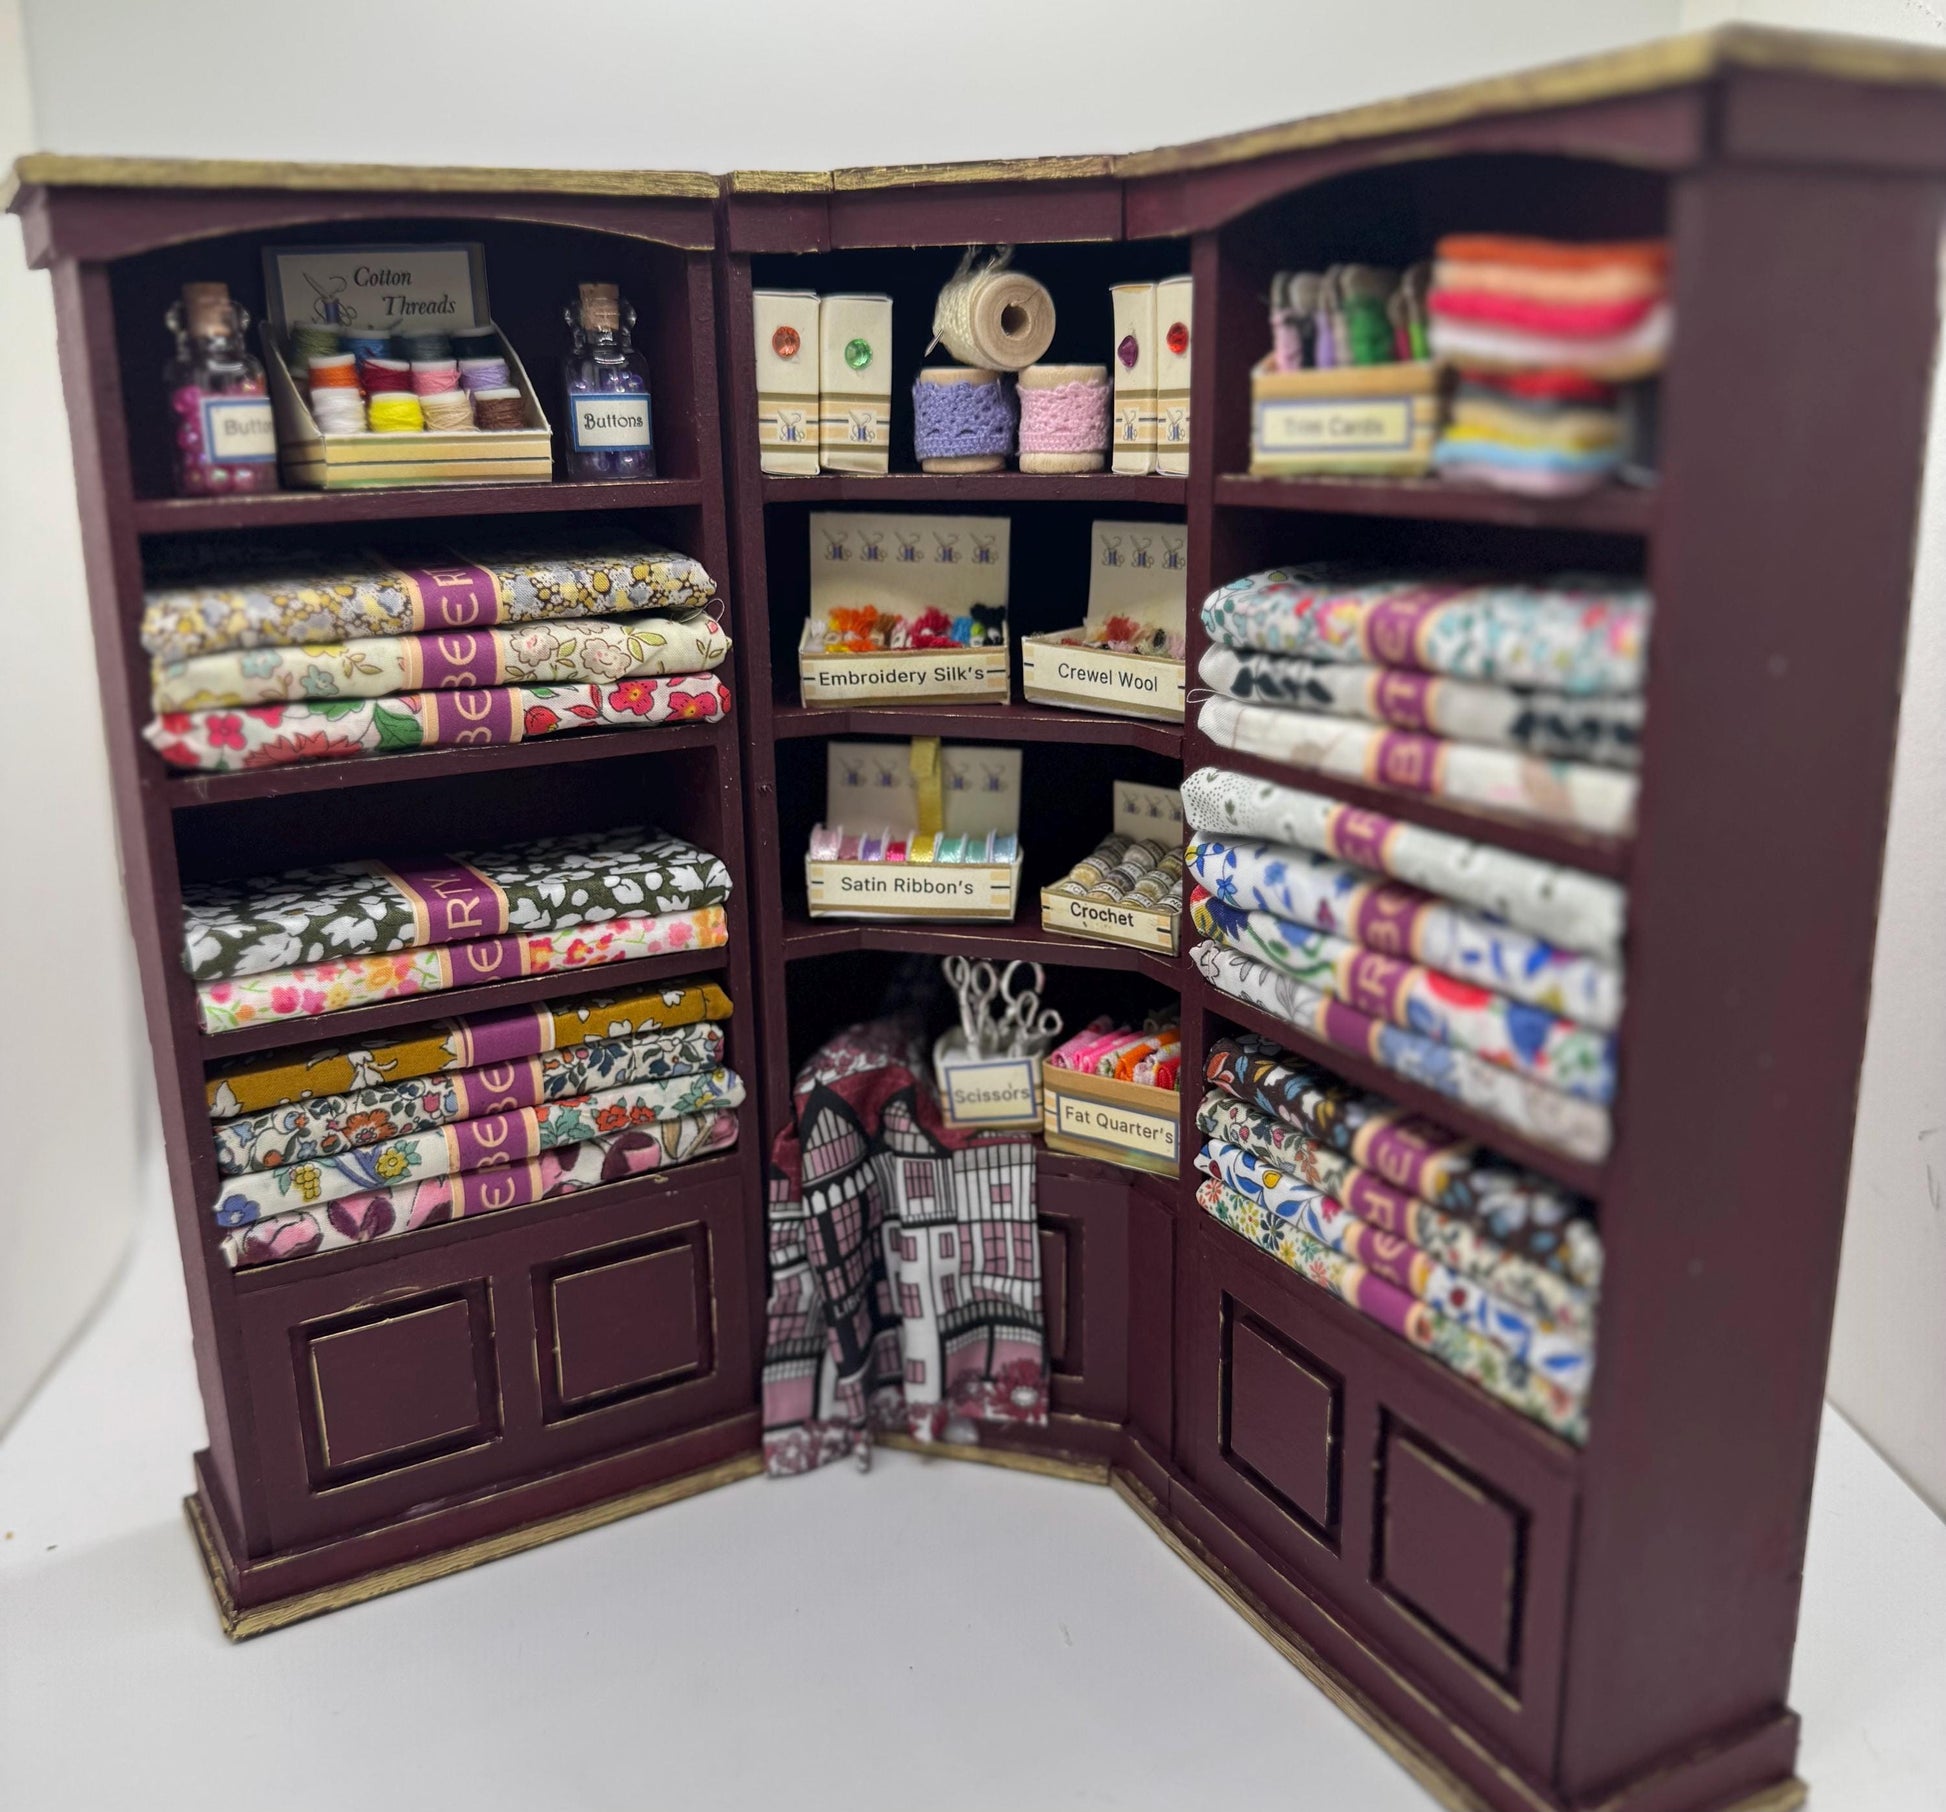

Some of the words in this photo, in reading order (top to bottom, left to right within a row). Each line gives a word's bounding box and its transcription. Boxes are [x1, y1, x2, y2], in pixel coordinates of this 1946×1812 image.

[354, 266, 412, 287] Cotton
[382, 294, 456, 316] Threads
[584, 413, 643, 430] Buttons
[819, 669, 926, 686] Embroidery
[934, 666, 984, 681] Silk's
[1058, 663, 1112, 685] Crewel
[1118, 671, 1158, 692] Wool
[841, 876, 887, 892] Satin
[894, 877, 974, 894] Ribbon's
[1070, 902, 1134, 927] Crochet
[954, 1086, 1031, 1104] Scissors
[1065, 1105, 1091, 1125] Fat
[1096, 1113, 1174, 1144] Quarter's
